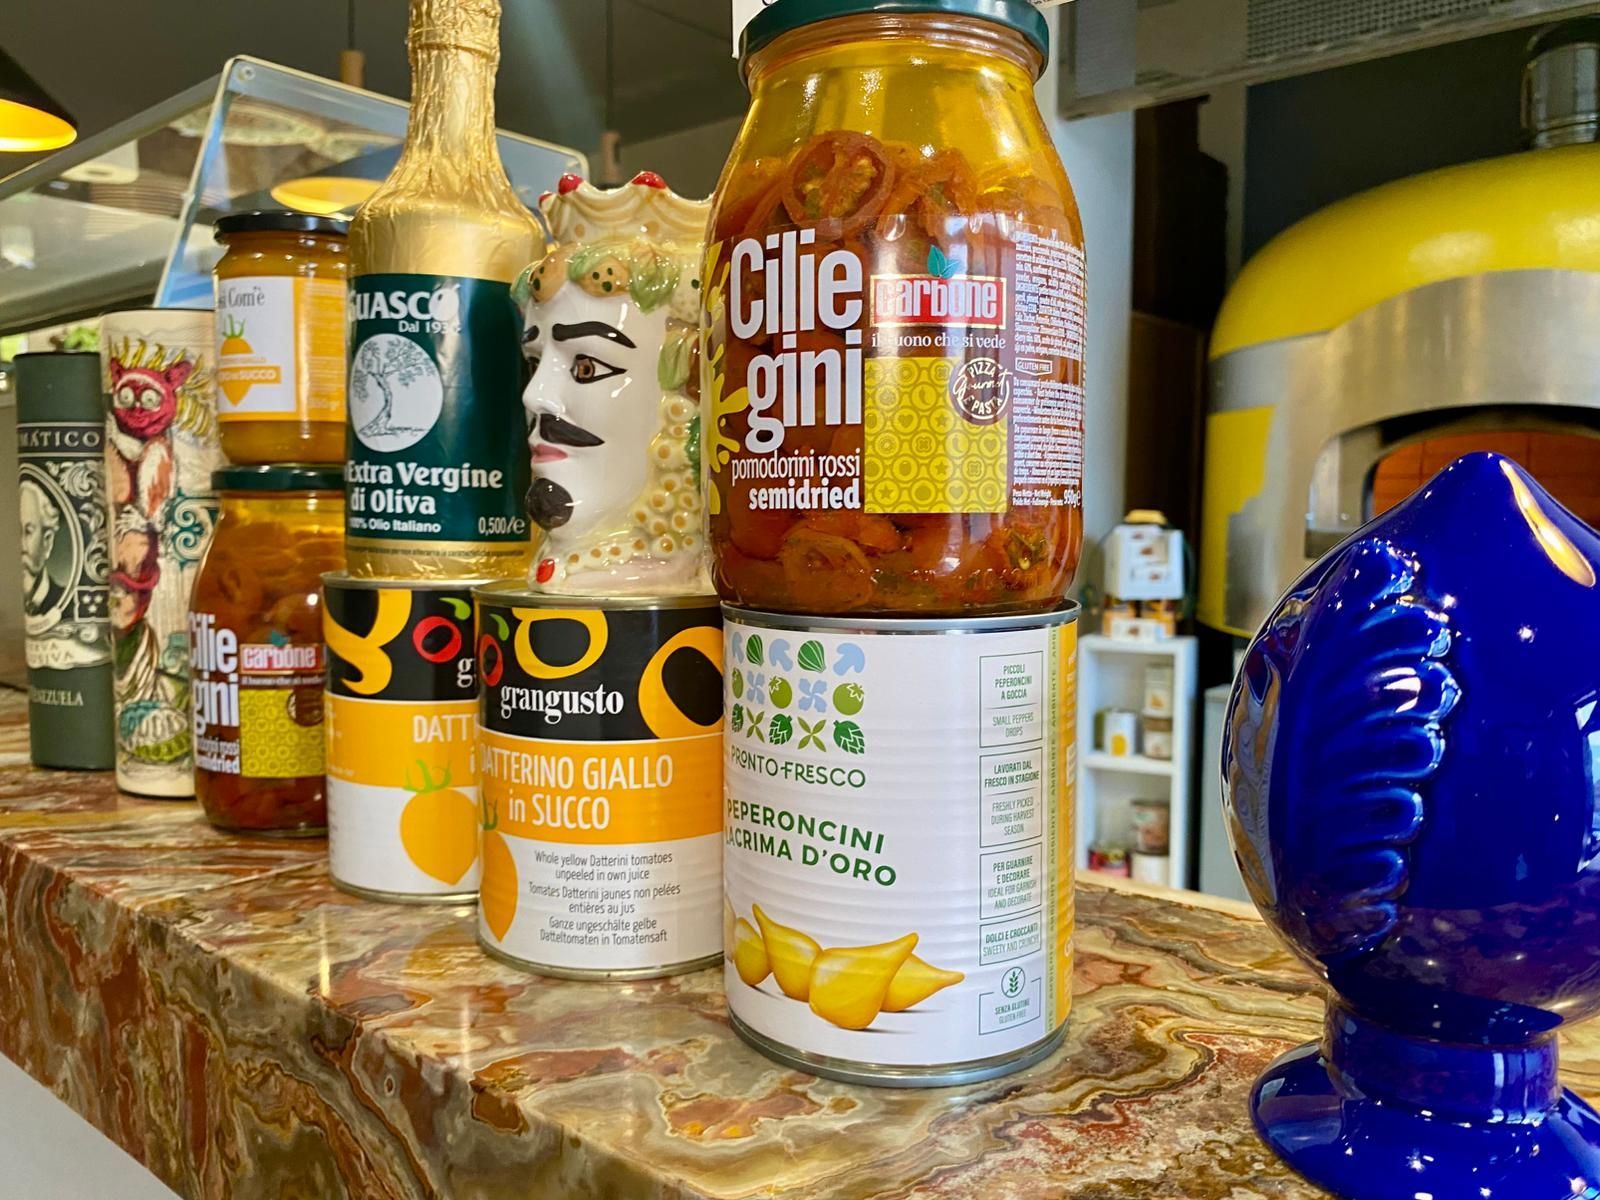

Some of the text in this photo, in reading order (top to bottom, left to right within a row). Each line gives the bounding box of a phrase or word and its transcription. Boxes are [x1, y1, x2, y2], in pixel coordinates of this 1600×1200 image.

[730, 228, 863, 340] Cilie
[875, 279, 997, 319] carbone
[398, 320, 419, 333] Dal
[934, 331, 961, 348] che
[962, 333, 974, 348] si
[976, 334, 1007, 349] vede
[966, 361, 997, 379] PIZZA
[1017, 361, 1039, 371] GLUTEN
[744, 329, 863, 454] gini
[344, 460, 503, 493] Extra Vergine
[731, 448, 860, 487] pomodorini rossi
[351, 487, 437, 515] di Oliva
[749, 477, 861, 510] semidried
[368, 517, 390, 531] Olio
[392, 519, 442, 533] Italiano
[243, 646, 317, 670] carbone
[1003, 664, 1025, 675] PICCOLI
[994, 675, 1033, 688] PEPERONCINI
[1001, 688, 1027, 700] A GOCCIA
[193, 670, 240, 738] gini
[501, 684, 625, 725] grangusto
[992, 712, 1034, 726] SMALL PEPPERS
[1005, 726, 1023, 738] DROPS
[480, 743, 674, 791] DATTERINO GIALLO
[993, 760, 1032, 775] LAVORATI DAL
[984, 770, 1040, 788] FRESCO IN STAGIONE
[509, 789, 611, 830] in SUCCO
[992, 796, 1034, 813] FRESHLY PICKED
[990, 807, 1034, 826] DURING HARVEST
[727, 799, 885, 854] PEPERONCINI
[1003, 823, 1024, 836] SEASON
[534, 850, 673, 868] Whole yellow Datterini tomatoes
[802, 844, 897, 887] D'ORO
[993, 855, 1033, 873] PER GUARNIRE
[555, 868, 650, 883] unpeeled in own juice
[996, 868, 1030, 884] E DECORARE
[528, 881, 681, 902] Tomates Datterini jaunes non pelées
[987, 880, 1037, 898] IDEAL FOR GARNISH
[569, 902, 635, 916] entières au jus
[994, 892, 1032, 910] AND DECORATE
[549, 916, 657, 934] Ganze ungeschälte gelbe
[985, 922, 1038, 944] DOLCI E CROCCANTI
[539, 929, 667, 945] Datteltomaten in Tomatensaft
[983, 944, 1006, 957] SWEETY
[1006, 941, 1017, 952] AND
[994, 1004, 1011, 1015] SENZA
